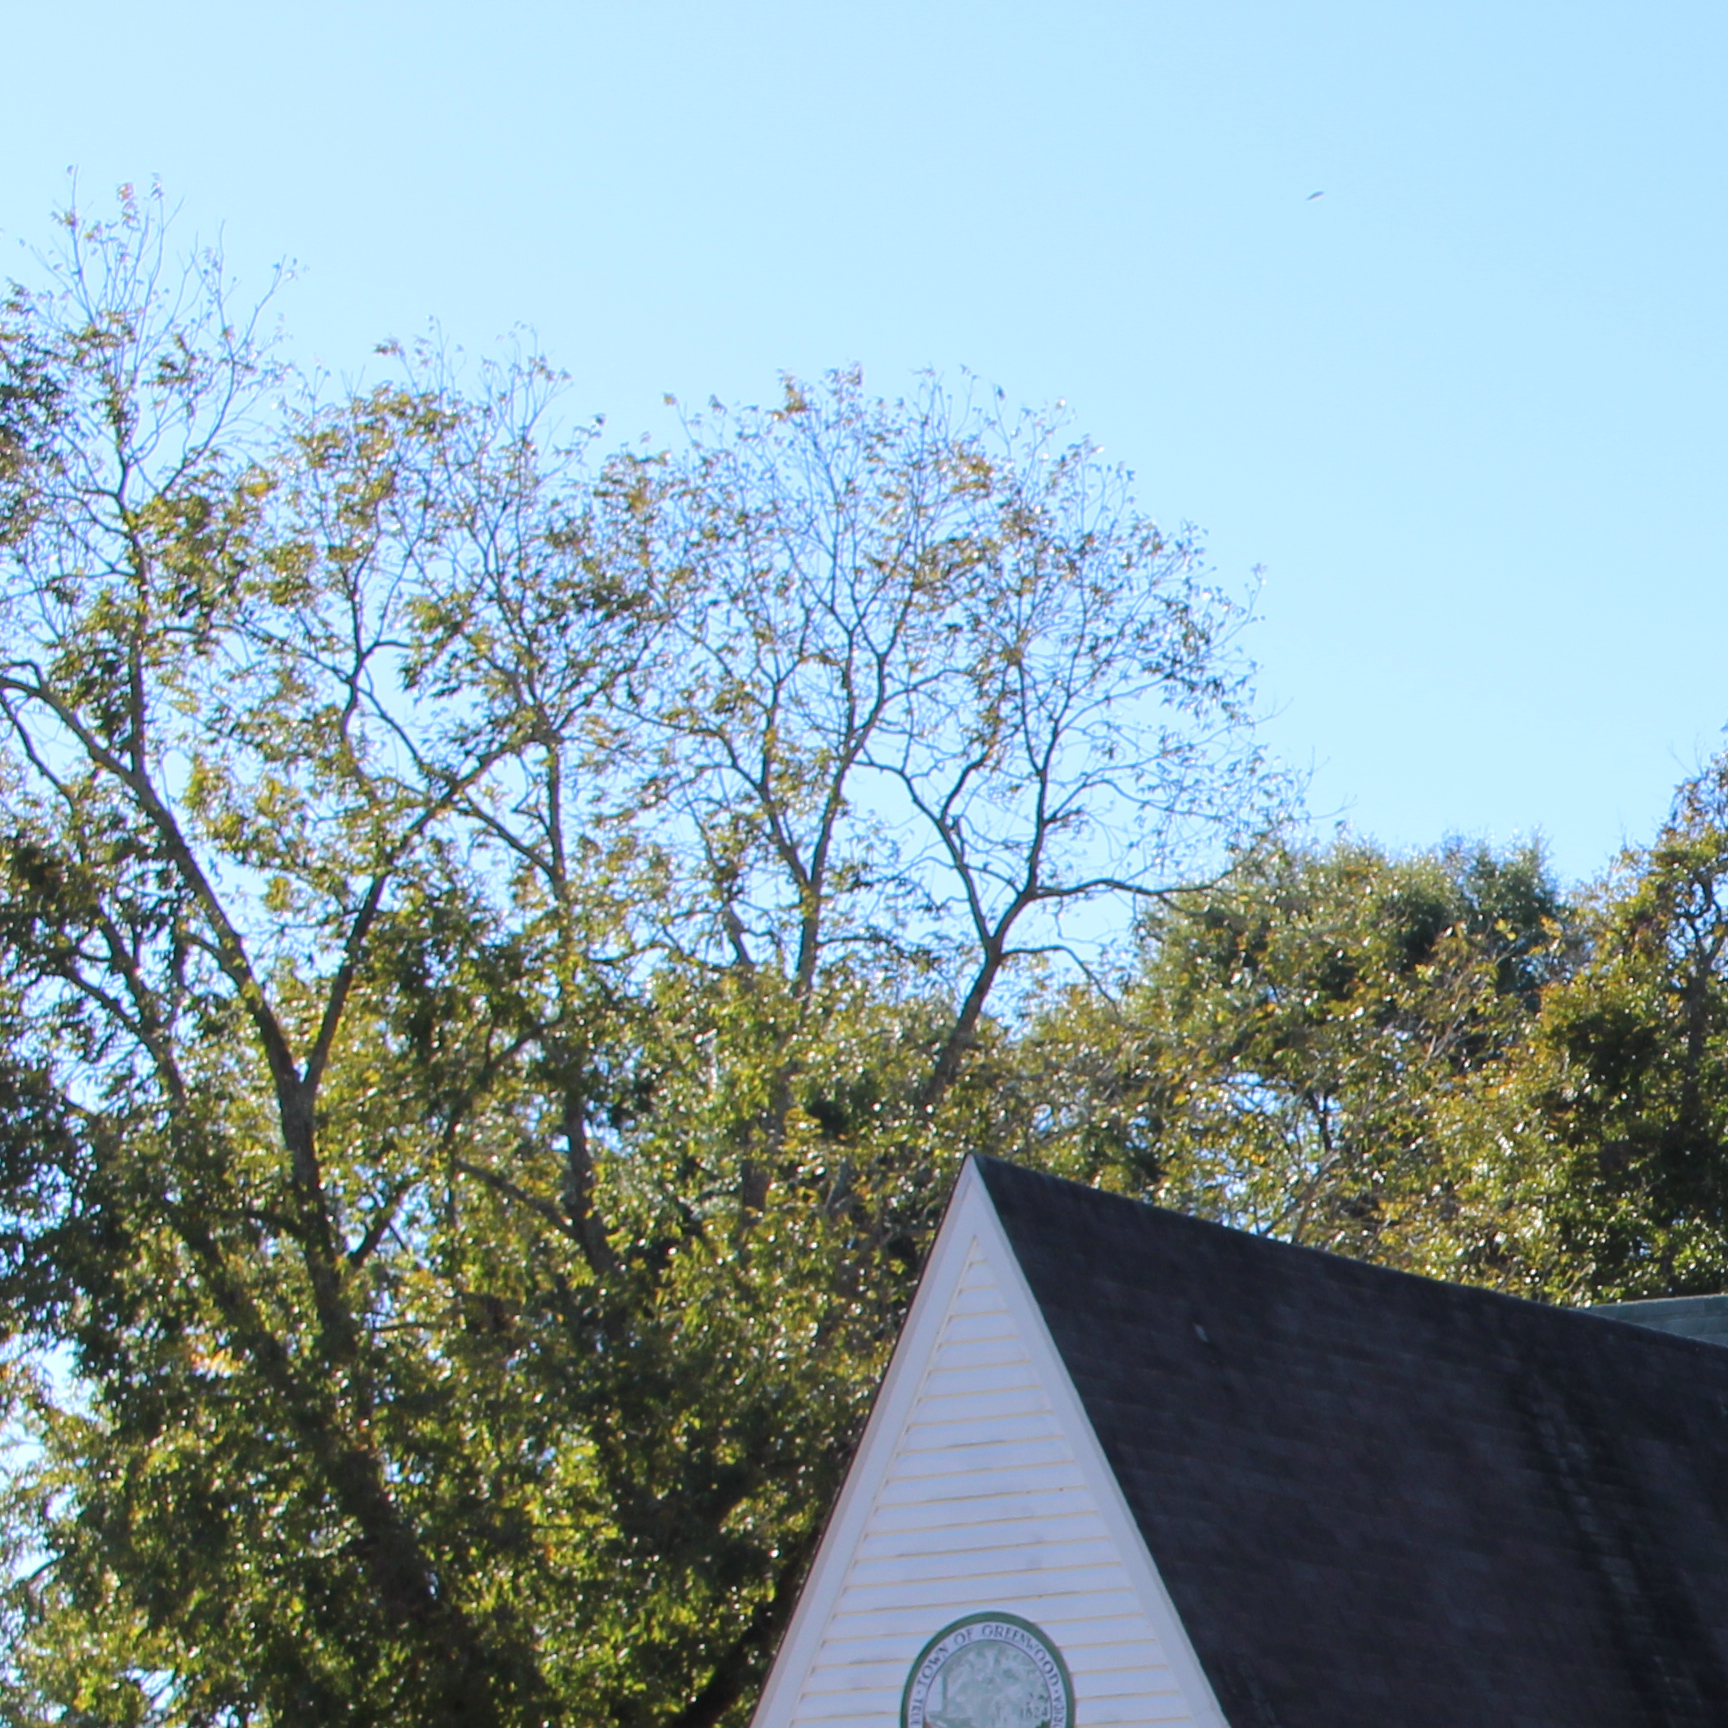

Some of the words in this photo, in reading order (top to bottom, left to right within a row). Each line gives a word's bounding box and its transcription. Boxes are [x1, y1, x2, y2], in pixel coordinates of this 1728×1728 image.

[917, 1644, 949, 1686] TOWN
[954, 1628, 974, 1645] OF
[982, 1624, 1060, 1686] GREENWOOD
